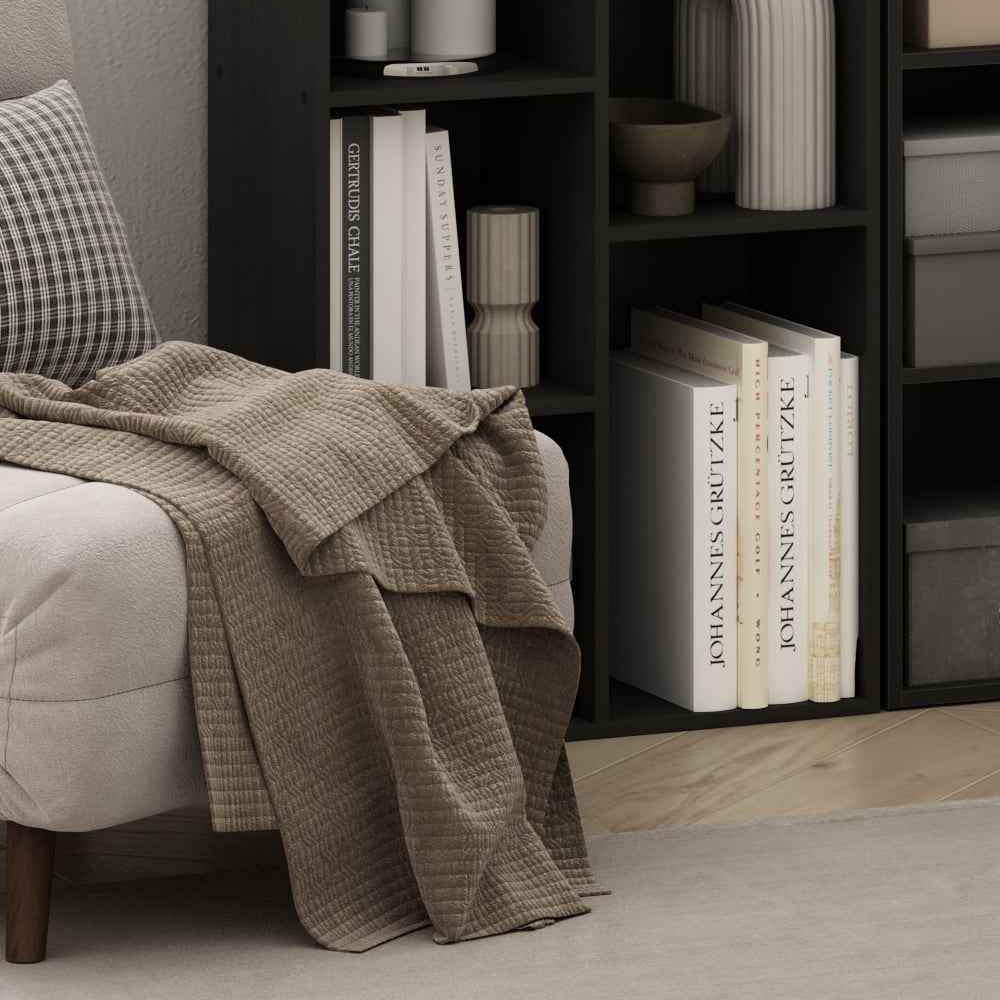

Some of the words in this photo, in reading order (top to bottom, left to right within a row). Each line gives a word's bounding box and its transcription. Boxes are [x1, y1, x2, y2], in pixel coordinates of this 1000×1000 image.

[348, 143, 360, 221] GERTRUDIS
[434, 145, 448, 207] SUNDAY
[348, 226, 360, 273] CHALE
[440, 214, 454, 282] SUPPERS
[708, 402, 724, 525] GRÜTZKE
[778, 377, 794, 505] GRÜTZKE
[709, 532, 724, 668] JOHANNES
[780, 511, 796, 652] JOHANNES
